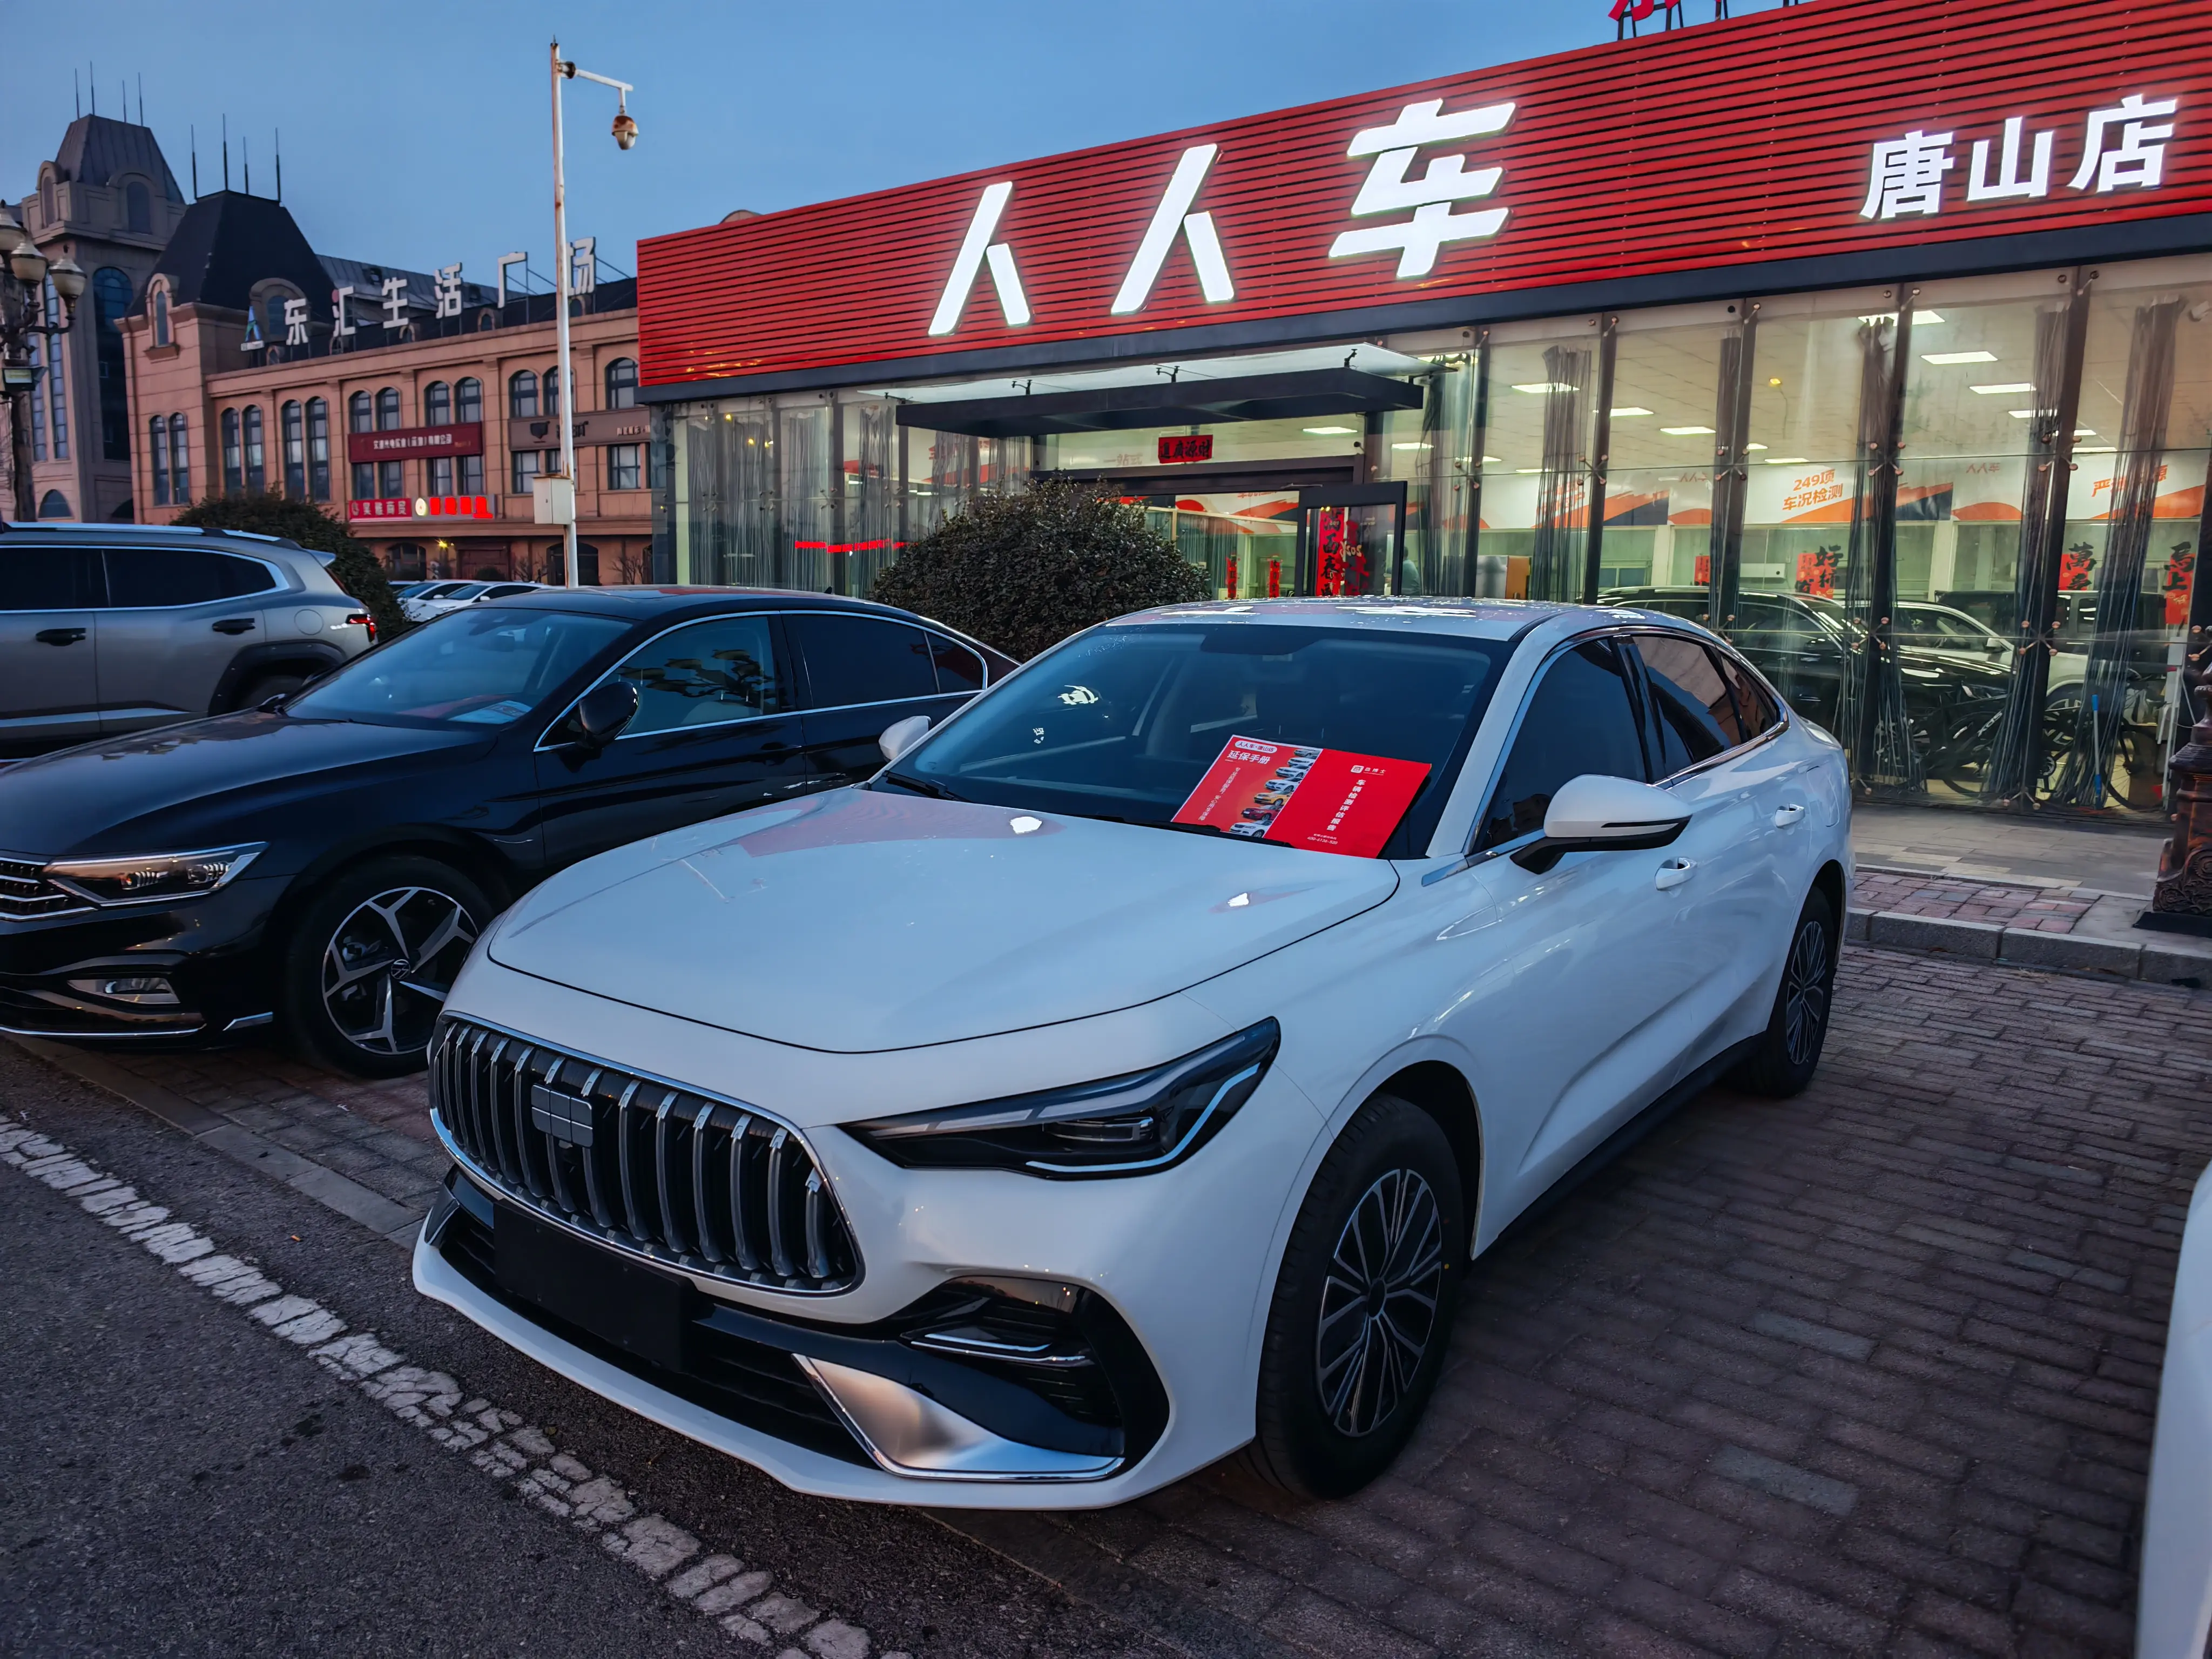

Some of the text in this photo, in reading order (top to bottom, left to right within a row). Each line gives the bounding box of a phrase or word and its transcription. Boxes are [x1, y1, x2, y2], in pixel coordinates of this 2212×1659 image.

[1859, 93, 2177, 220] 唐山店
[928, 98, 1516, 336] 人人车
[283, 237, 596, 346] 东汇生活广场
[1782, 483, 1843, 511] 车况检测
[1793, 468, 1836, 491] 249项
[1226, 750, 1271, 765] 延保手册
